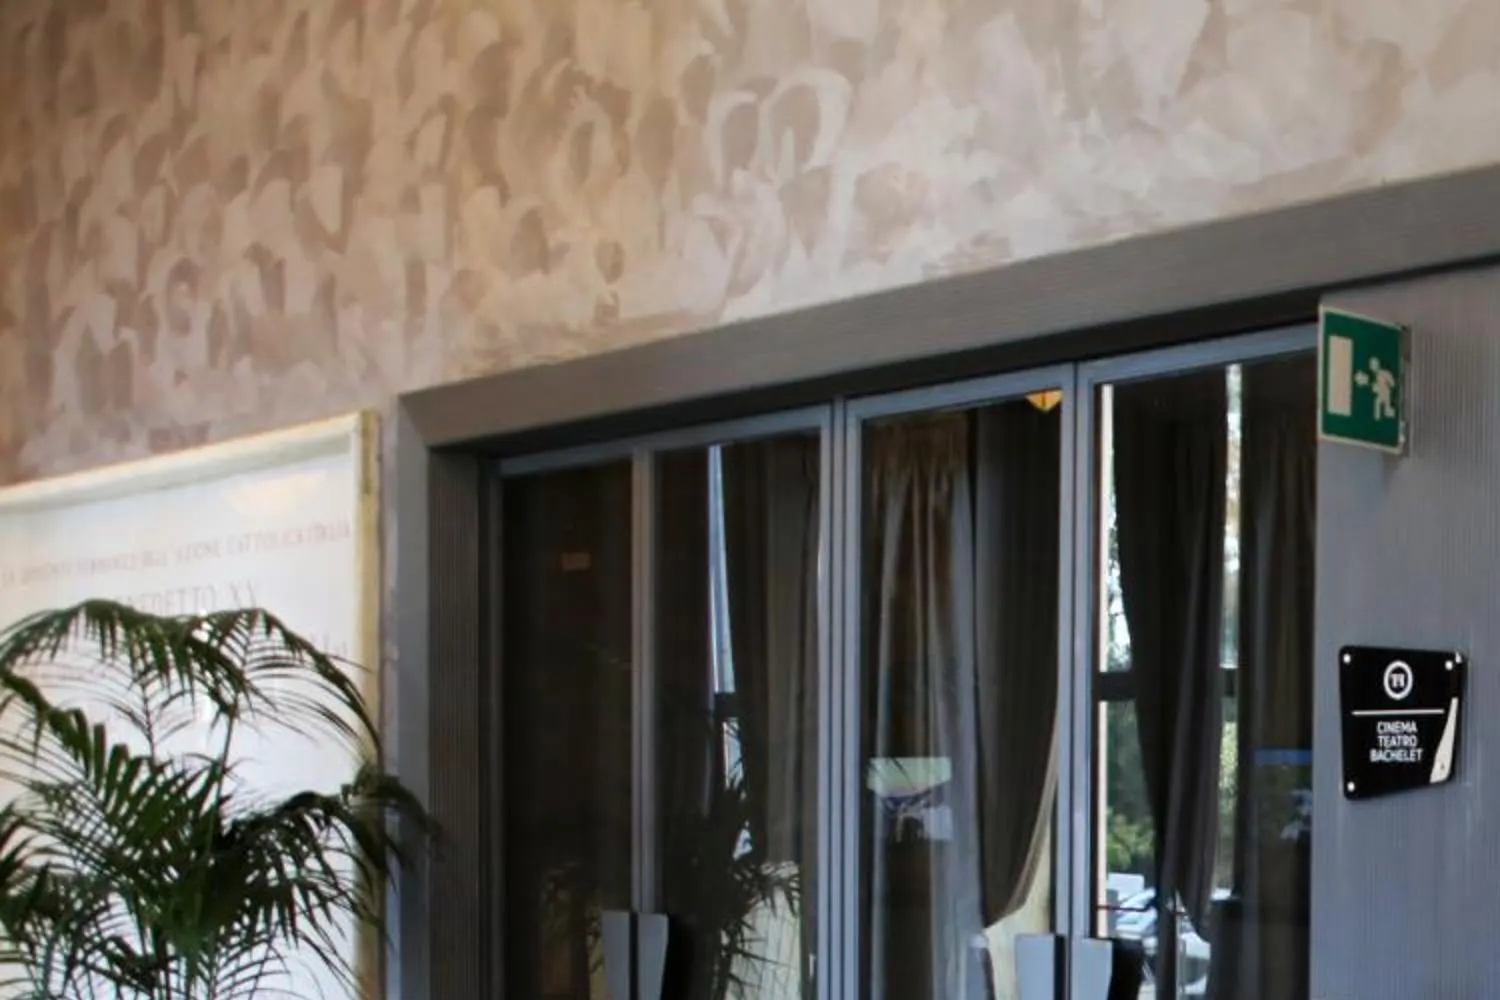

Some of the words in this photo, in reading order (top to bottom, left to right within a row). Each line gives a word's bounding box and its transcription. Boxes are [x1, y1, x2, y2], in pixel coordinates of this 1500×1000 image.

[1377, 720, 1417, 733] CINEMA
[1377, 735, 1417, 747] TEATRO
[1370, 748, 1423, 762] BACHELET
